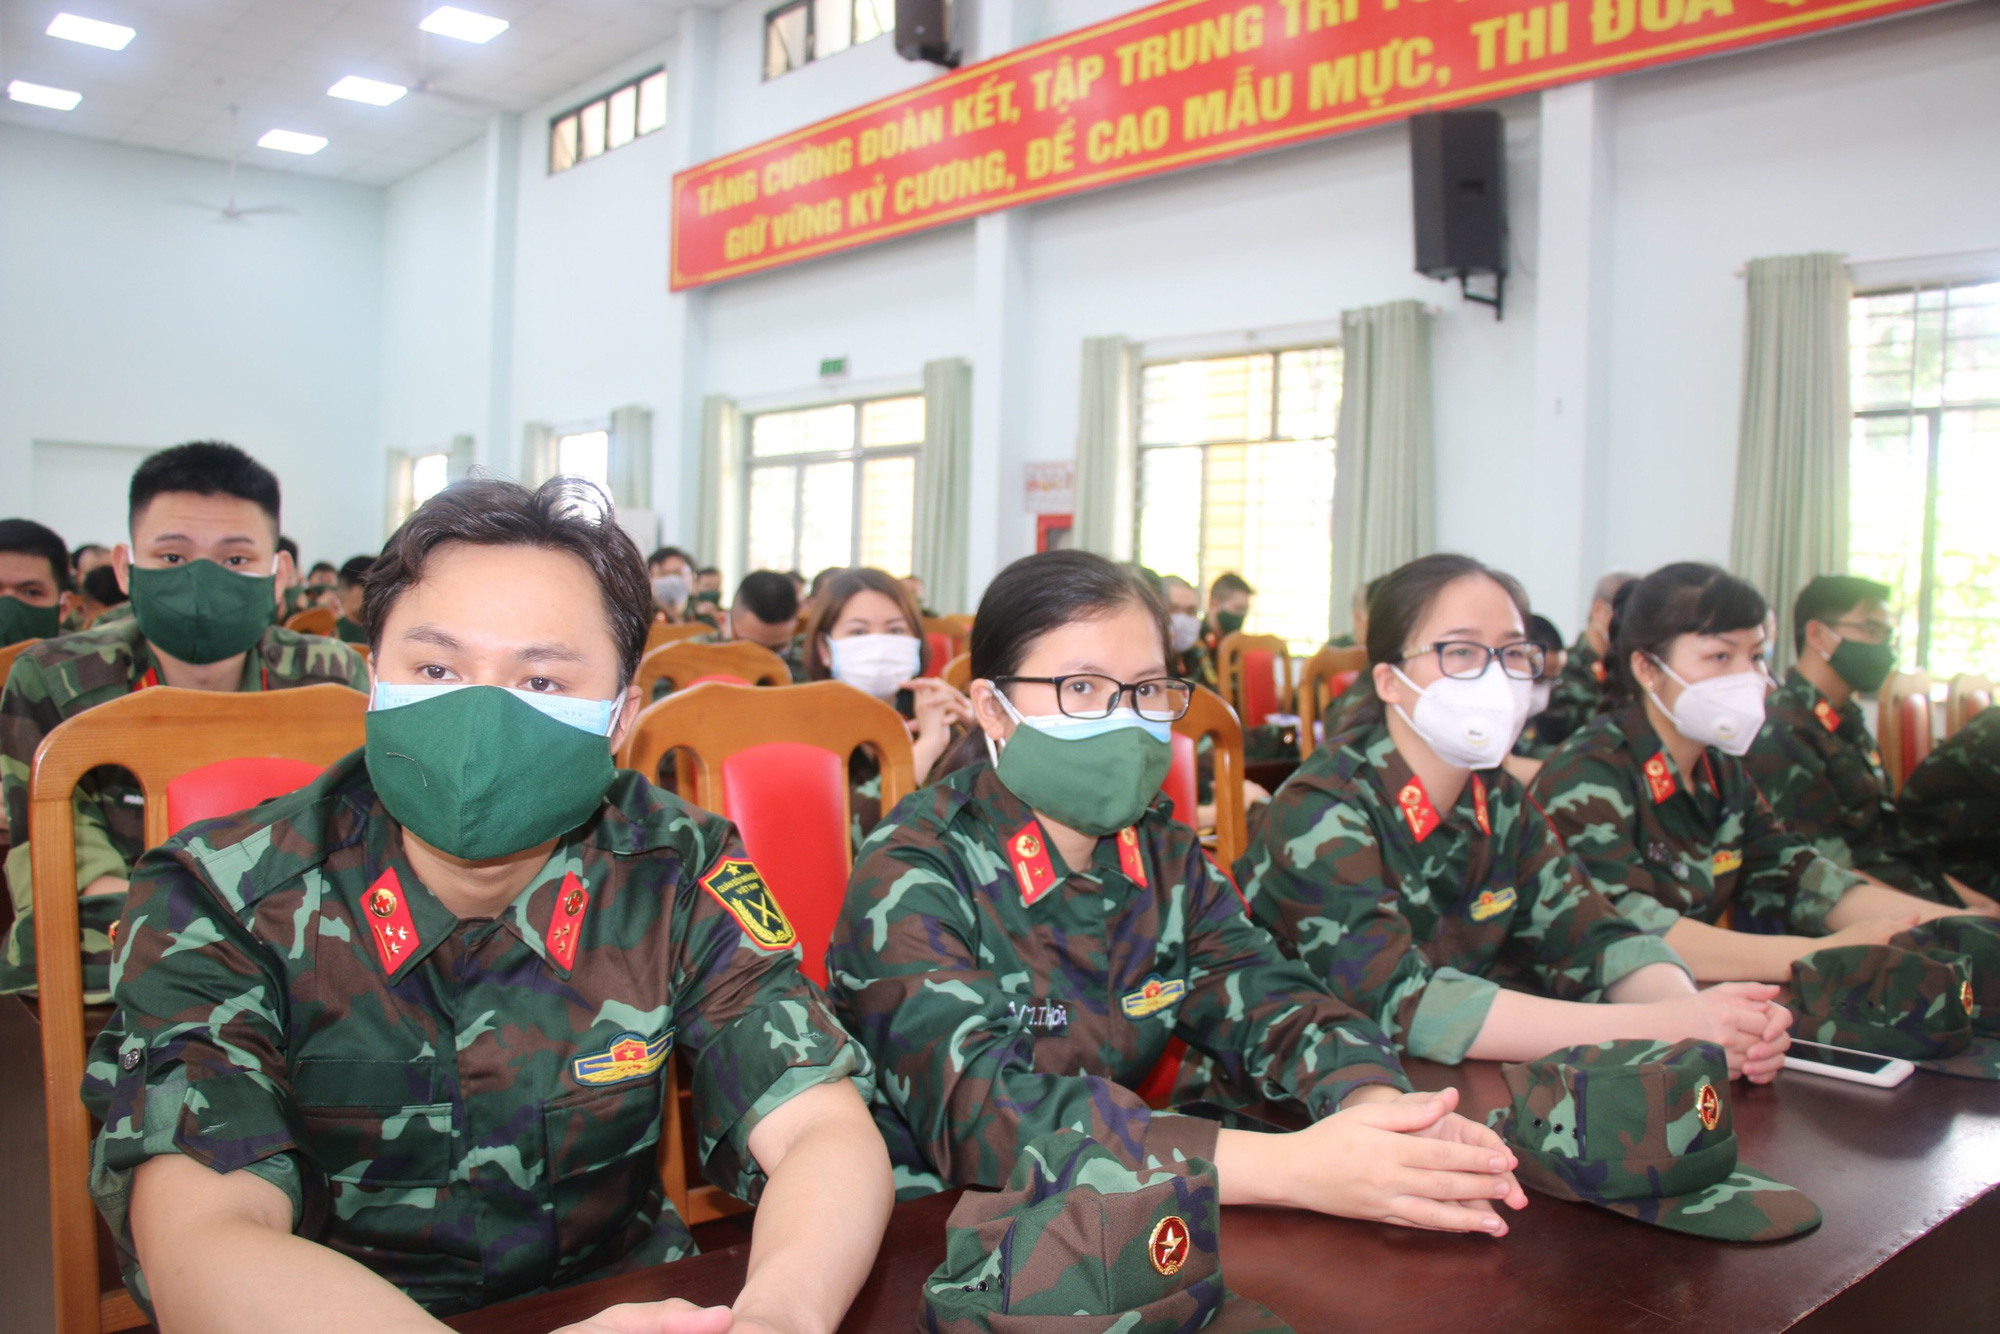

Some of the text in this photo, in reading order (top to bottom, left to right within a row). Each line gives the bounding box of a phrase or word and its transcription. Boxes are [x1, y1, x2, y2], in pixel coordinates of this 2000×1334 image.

[850, 173, 887, 228] KỶ
[1086, 105, 1171, 164] CAO
[1183, 64, 1292, 142] MẪU
[1308, 36, 1452, 112] MỰC,
[1470, 1, 1568, 72] THI
[859, 105, 945, 166] ĐOÀN
[953, 73, 1021, 137] KẾT,
[1030, 54, 1105, 114] TẬP
[1114, 4, 1265, 87] TRUNG
